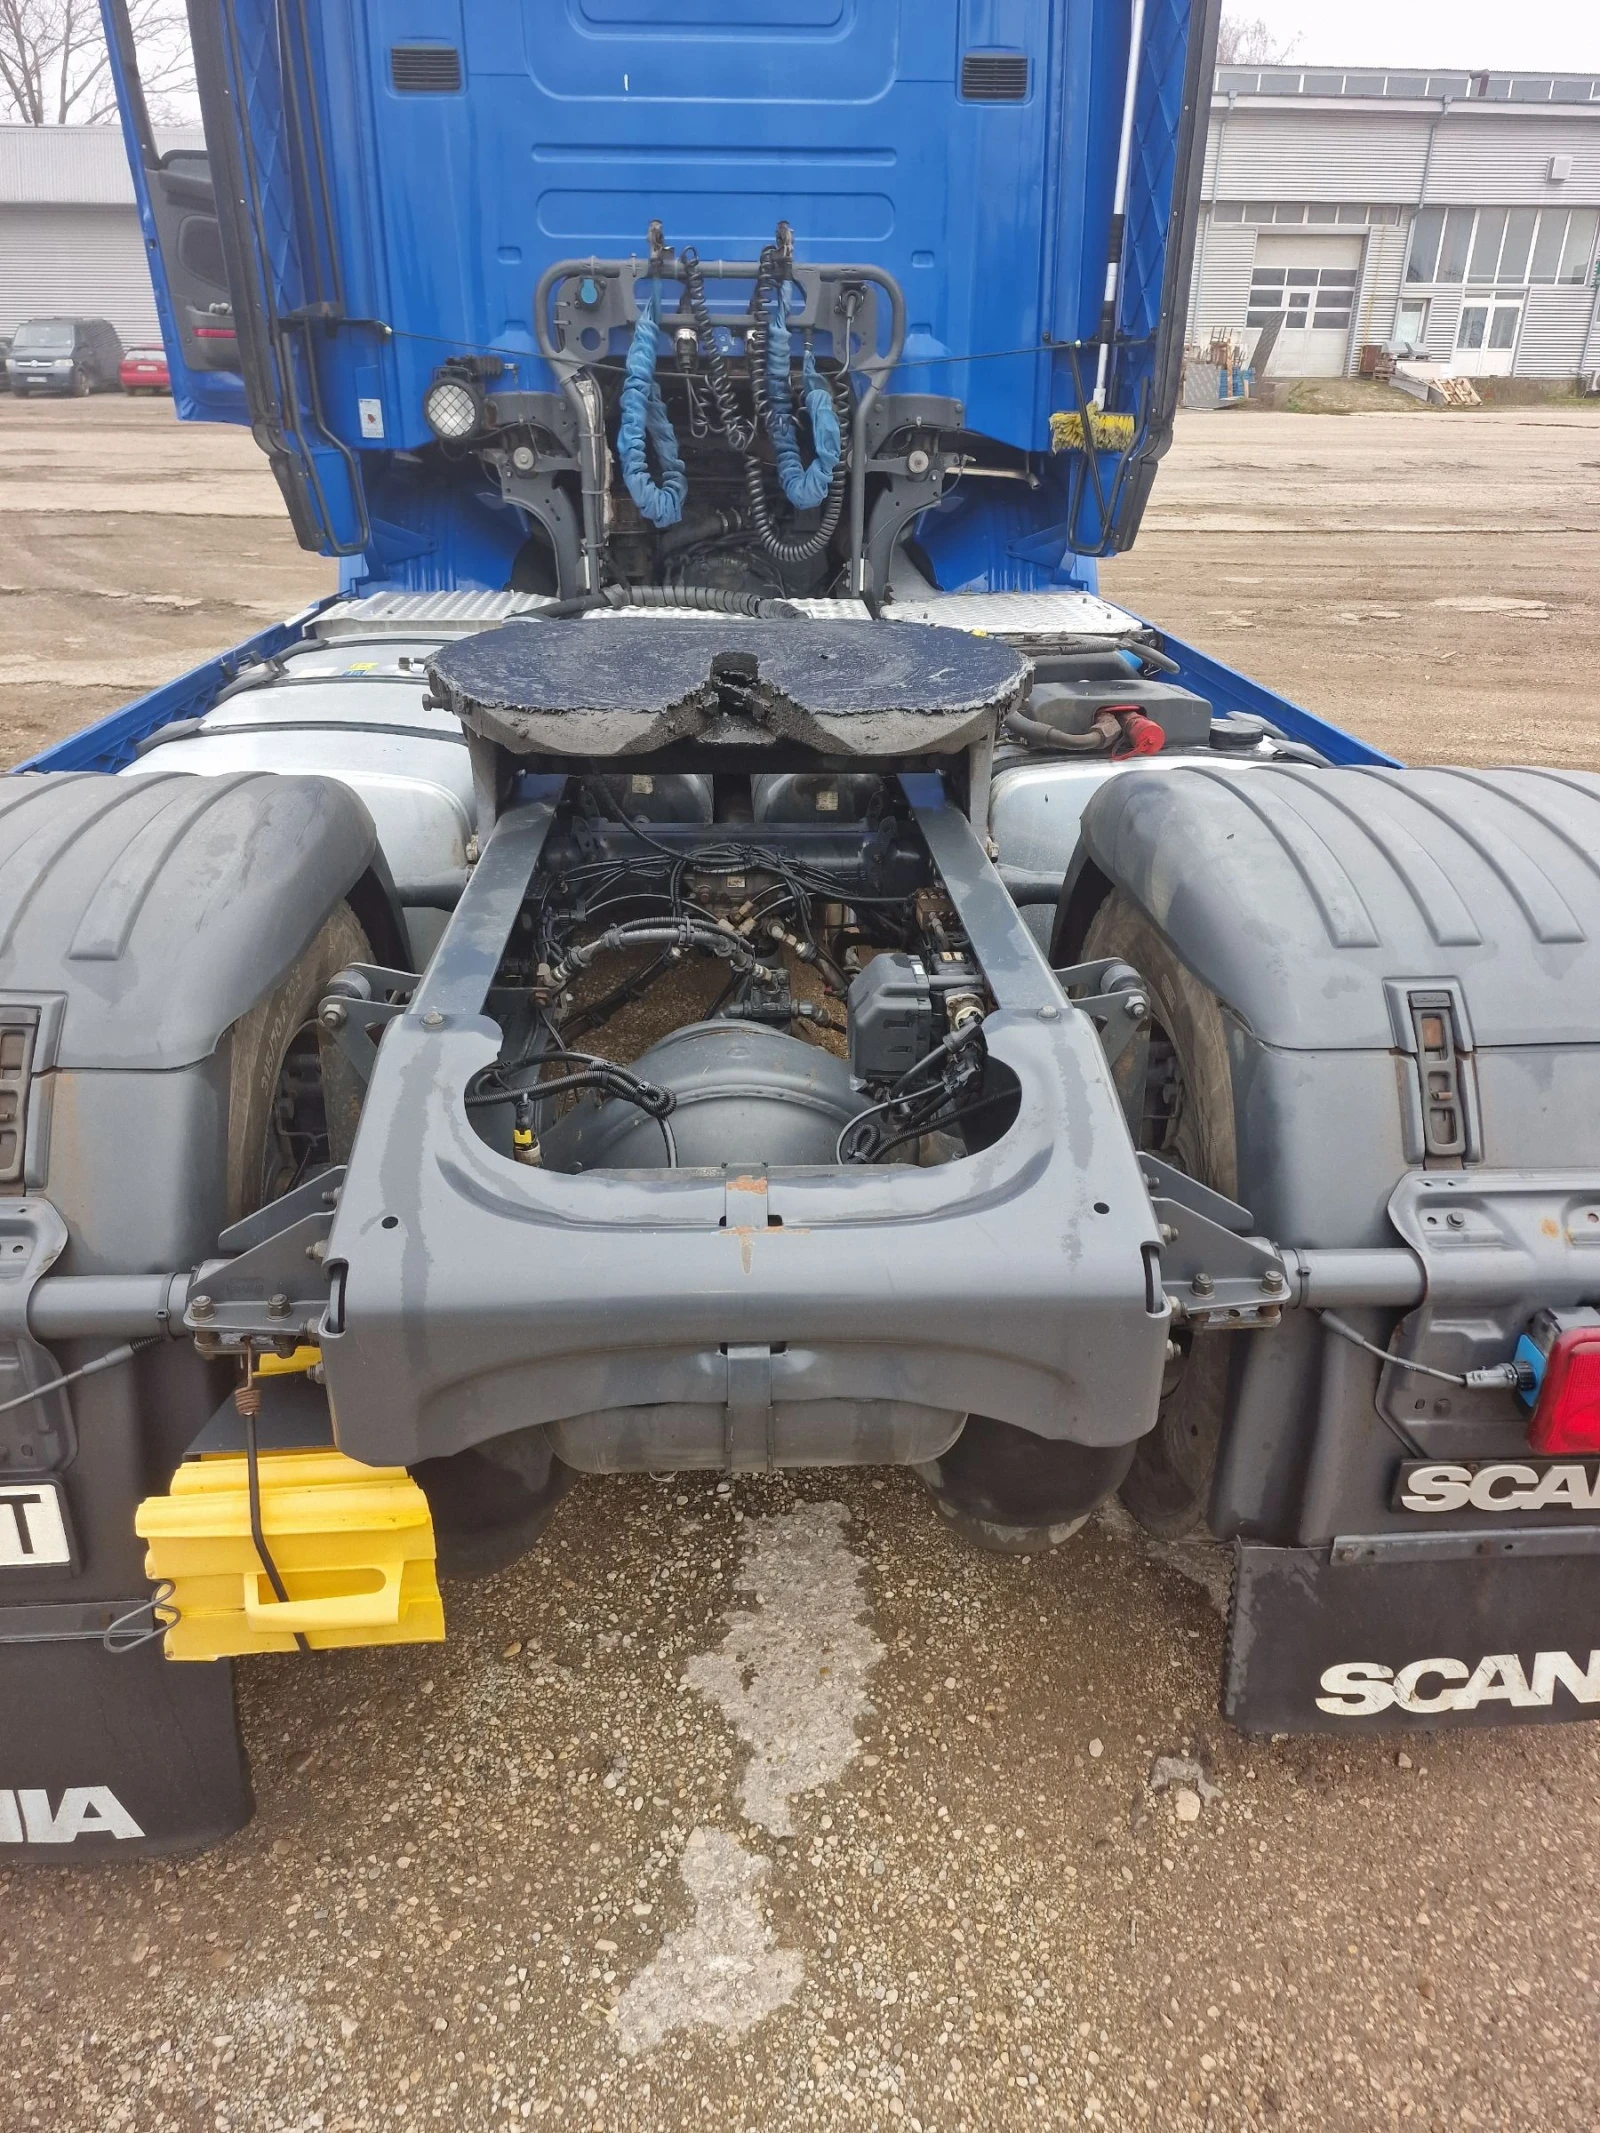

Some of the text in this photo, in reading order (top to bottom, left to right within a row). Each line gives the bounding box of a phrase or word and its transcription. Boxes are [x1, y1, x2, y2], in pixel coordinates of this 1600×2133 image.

[1401, 1465, 1600, 1512] SCA
[0, 1494, 42, 1554] T
[1315, 1650, 1600, 1716] SCAN
